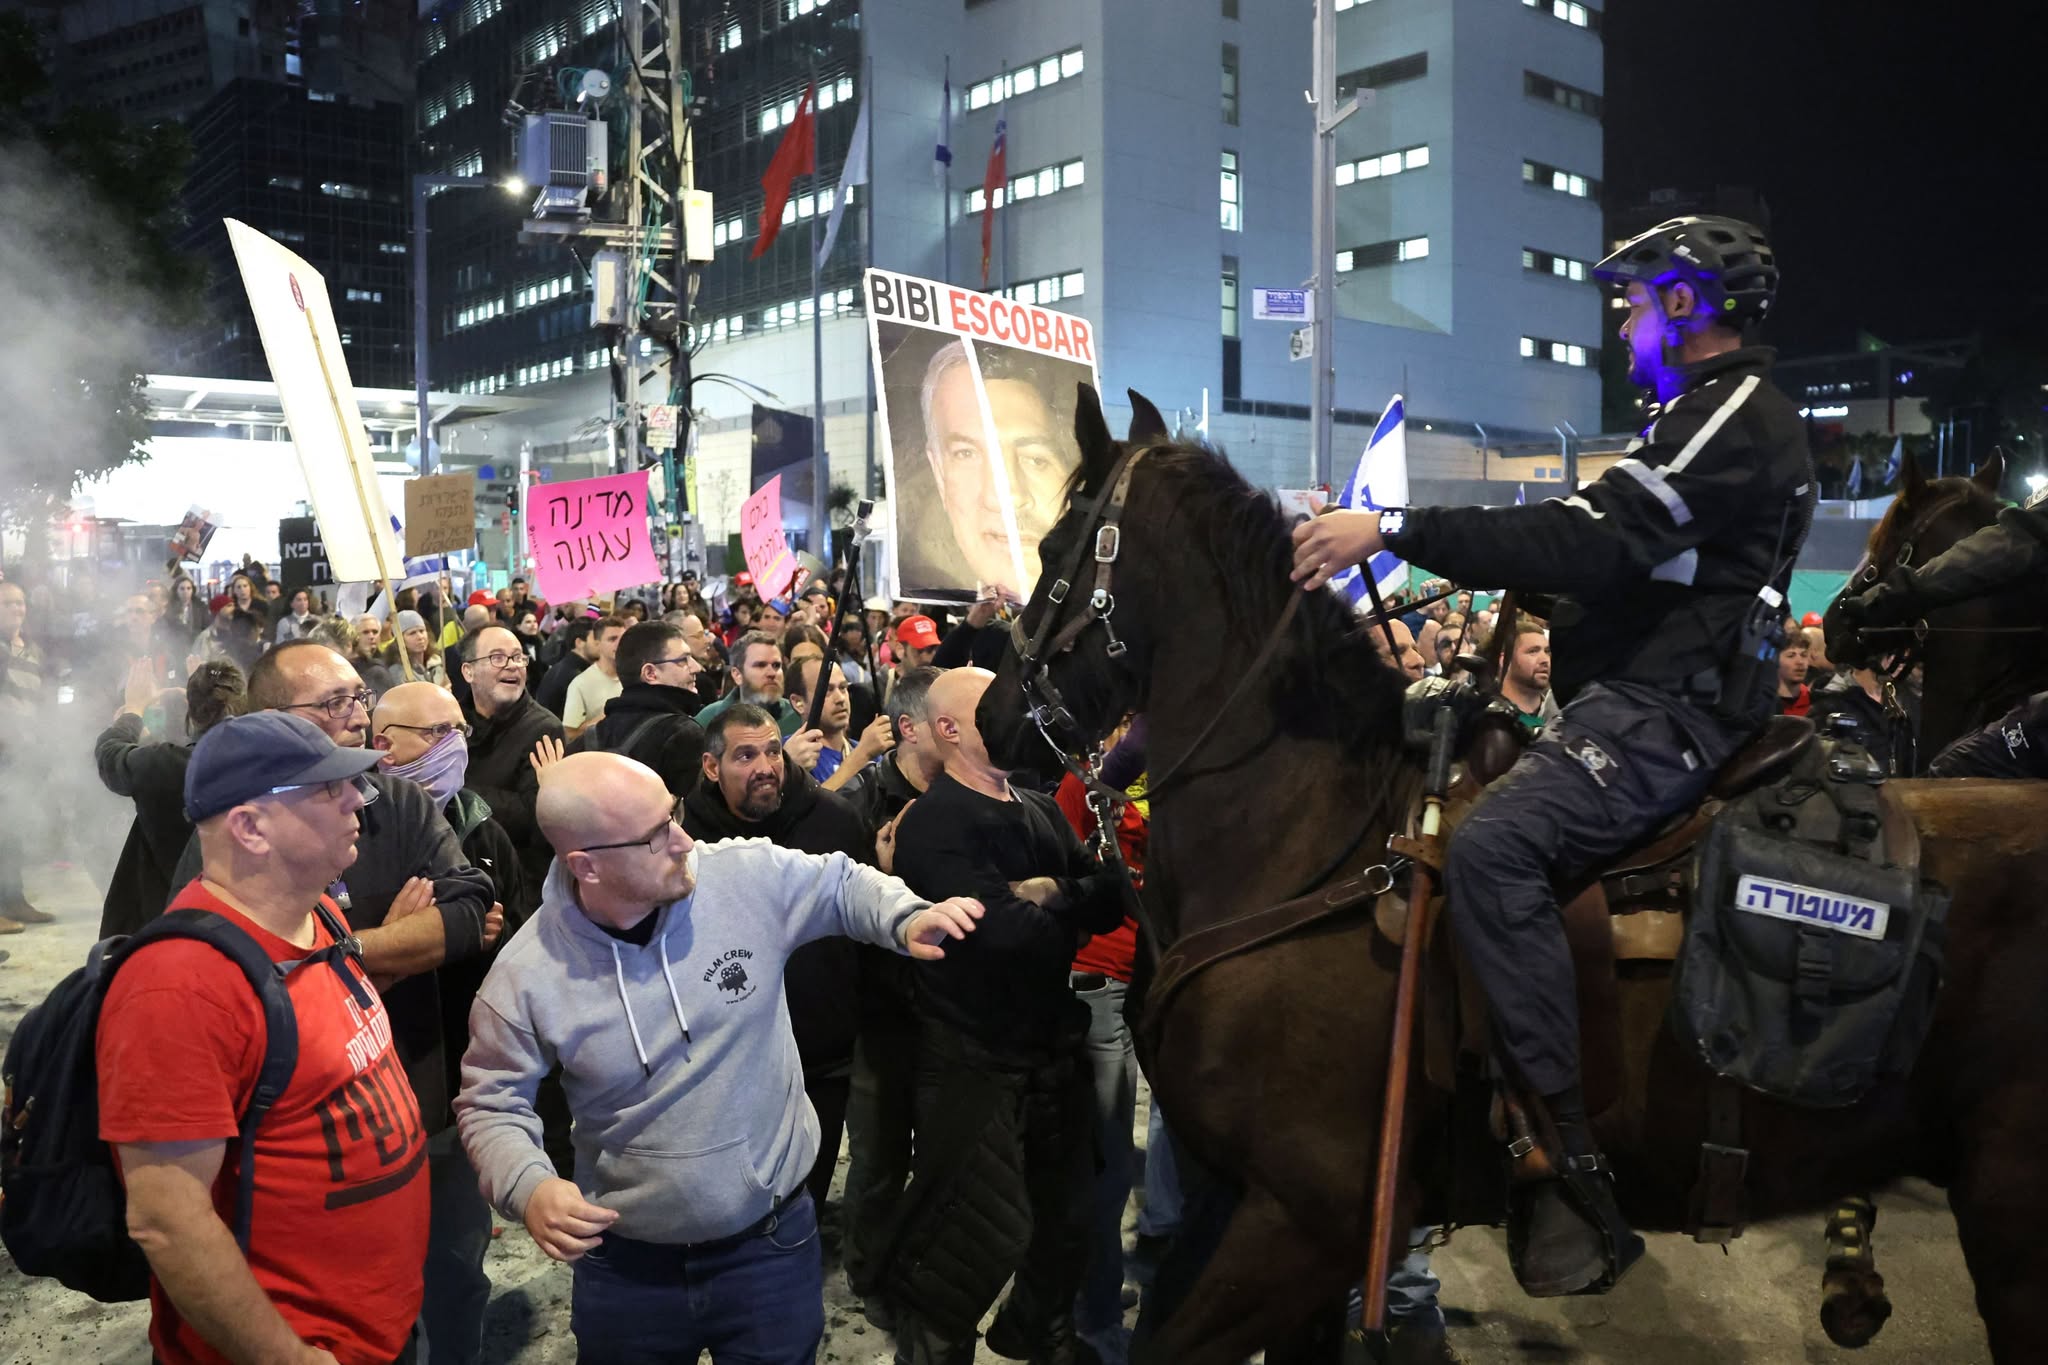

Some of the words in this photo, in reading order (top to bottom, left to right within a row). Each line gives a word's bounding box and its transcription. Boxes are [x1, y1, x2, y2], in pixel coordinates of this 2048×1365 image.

[871, 274, 940, 326] BIBI
[949, 290, 1092, 361] ESCOBAR
[549, 490, 634, 530] מדינה
[553, 527, 631, 571] עגונה
[1747, 884, 1875, 930] משטרה
[703, 958, 724, 982] FILM
[724, 949, 753, 960] CREW
